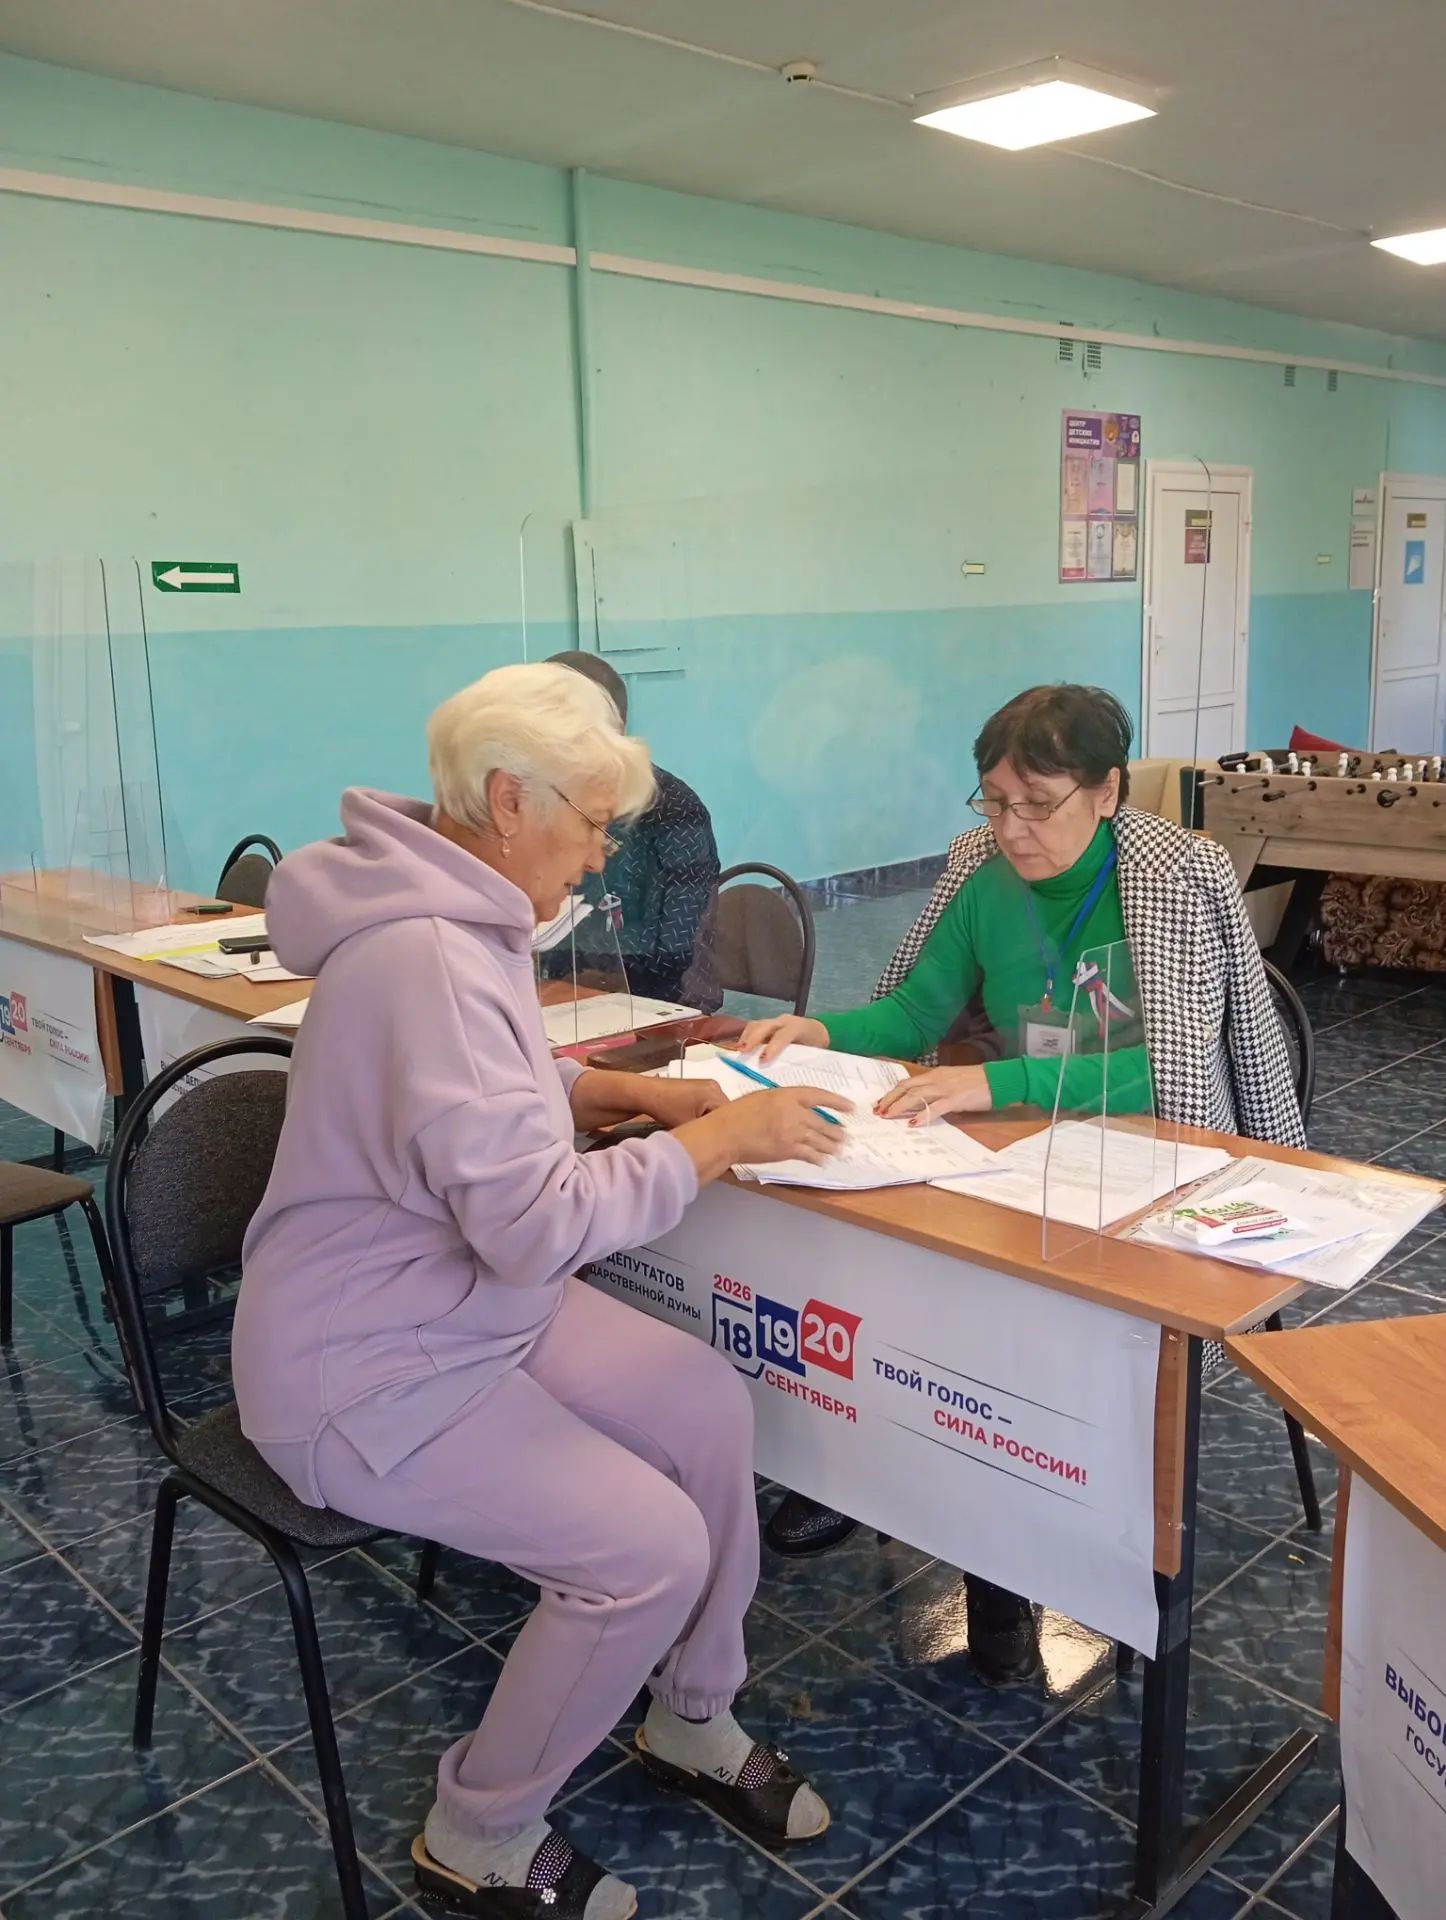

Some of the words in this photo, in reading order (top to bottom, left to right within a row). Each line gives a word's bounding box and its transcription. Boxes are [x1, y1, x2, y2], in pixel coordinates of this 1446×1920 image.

[11, 999, 25, 1023] 20
[590, 1263, 665, 1305] ДАРСТВЕННОЙ
[667, 1296, 701, 1320] ДУМЫ
[606, 1251, 685, 1292] ДЕПУТАТОВ
[713, 1273, 752, 1301] 2026
[718, 1317, 752, 1359] 18
[759, 1314, 796, 1358] 19
[804, 1313, 851, 1362] 20
[765, 1369, 857, 1423] СЕНТЯБРЯ
[872, 1357, 923, 1393] ТВОЙ
[927, 1380, 993, 1421] ГОЛОС
[933, 1409, 987, 1445] СИЛА
[992, 1432, 1088, 1486] РОССИИ!
[713, 1766, 735, 1784] NI
[1406, 1723, 1446, 1787] ГОСУ
